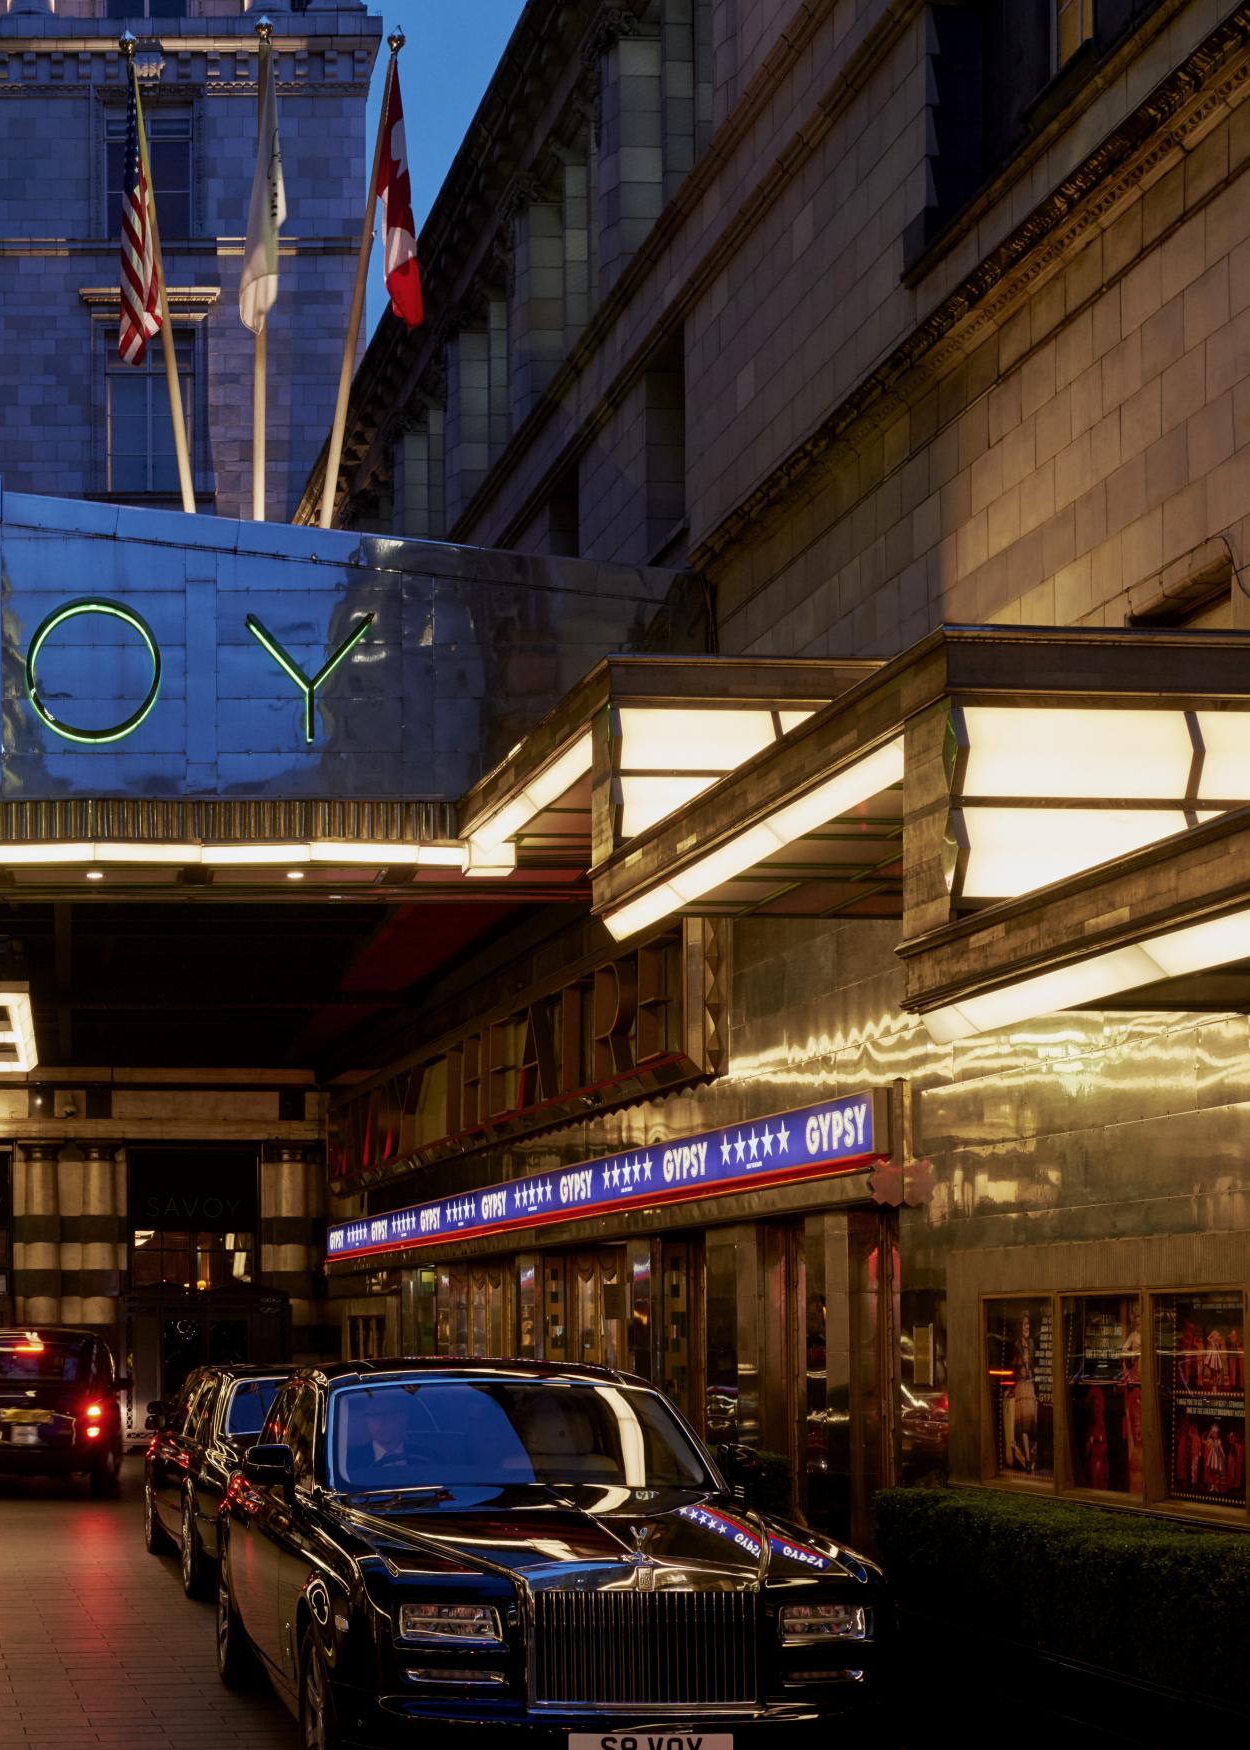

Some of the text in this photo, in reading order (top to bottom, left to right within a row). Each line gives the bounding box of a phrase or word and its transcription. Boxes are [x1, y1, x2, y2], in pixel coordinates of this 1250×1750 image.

[329, 1103, 867, 1250] GYPSY GYPSY GYPSY GYPSY GYPSY GYPSY GYPSY
[145, 1195, 242, 1218] SAVOY
[1038, 1393, 1055, 1403] GYPS
